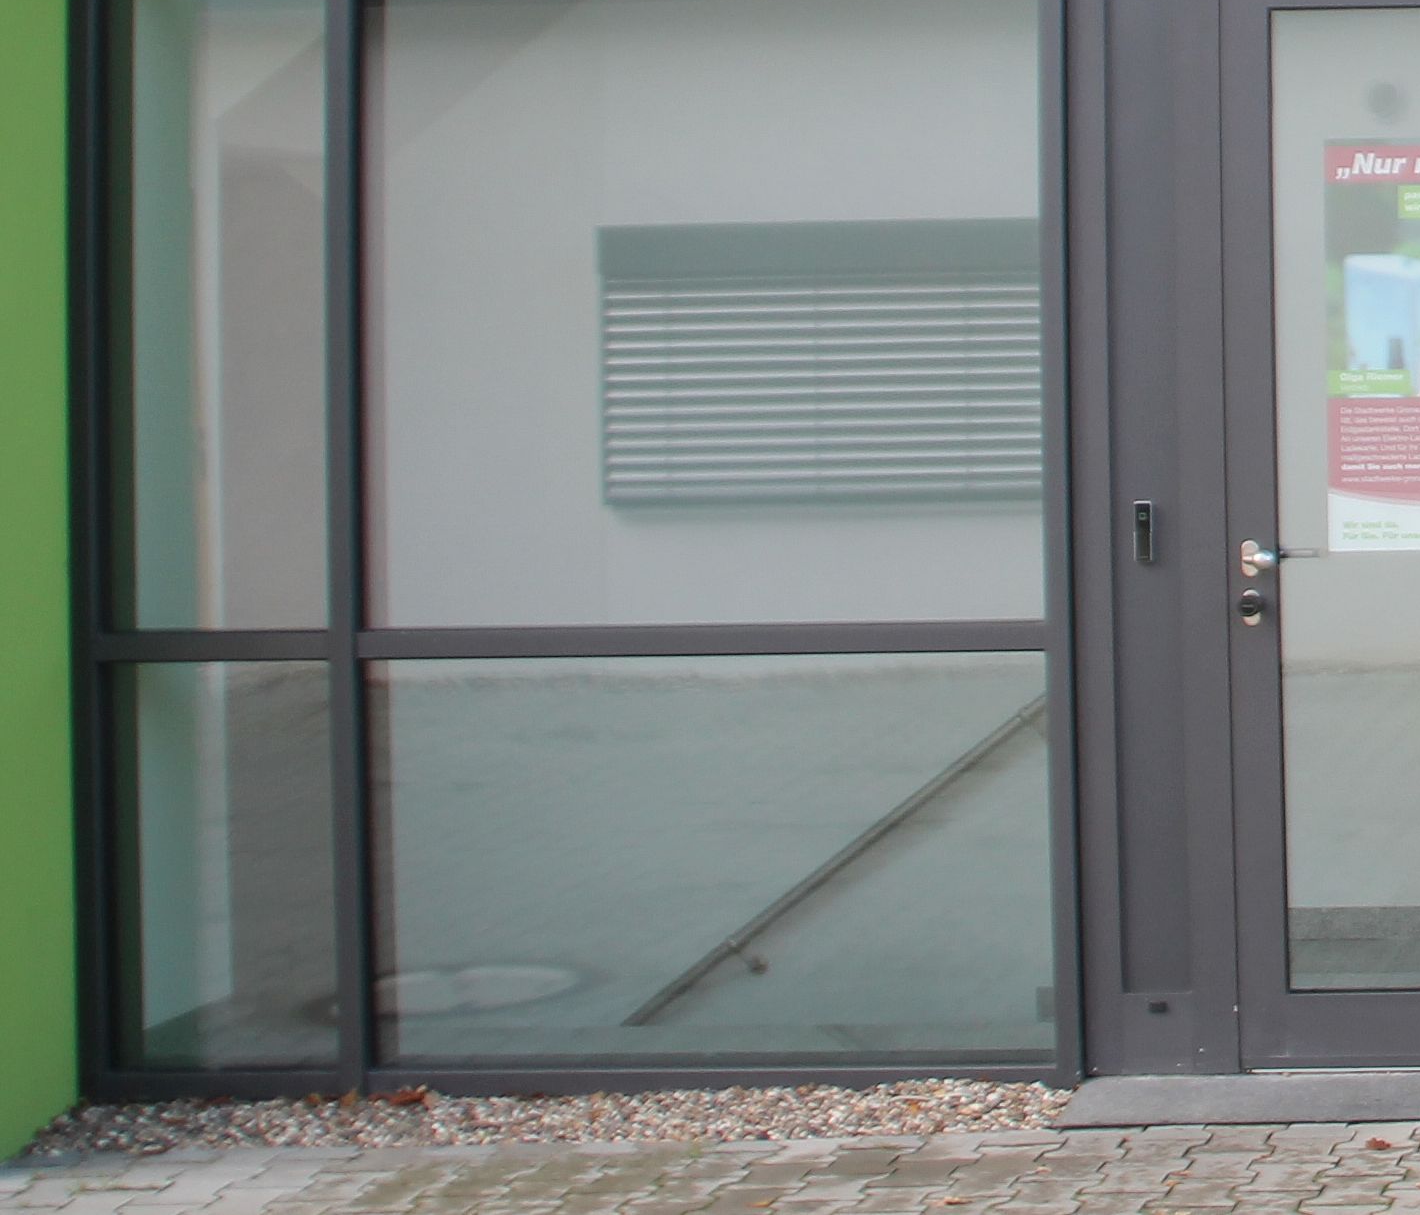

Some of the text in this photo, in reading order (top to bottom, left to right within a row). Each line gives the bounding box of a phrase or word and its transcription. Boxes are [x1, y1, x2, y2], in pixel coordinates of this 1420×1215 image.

[1335, 151, 1407, 179] „Nur
[1340, 463, 1365, 471] damit
[1366, 462, 1381, 470] Sie
